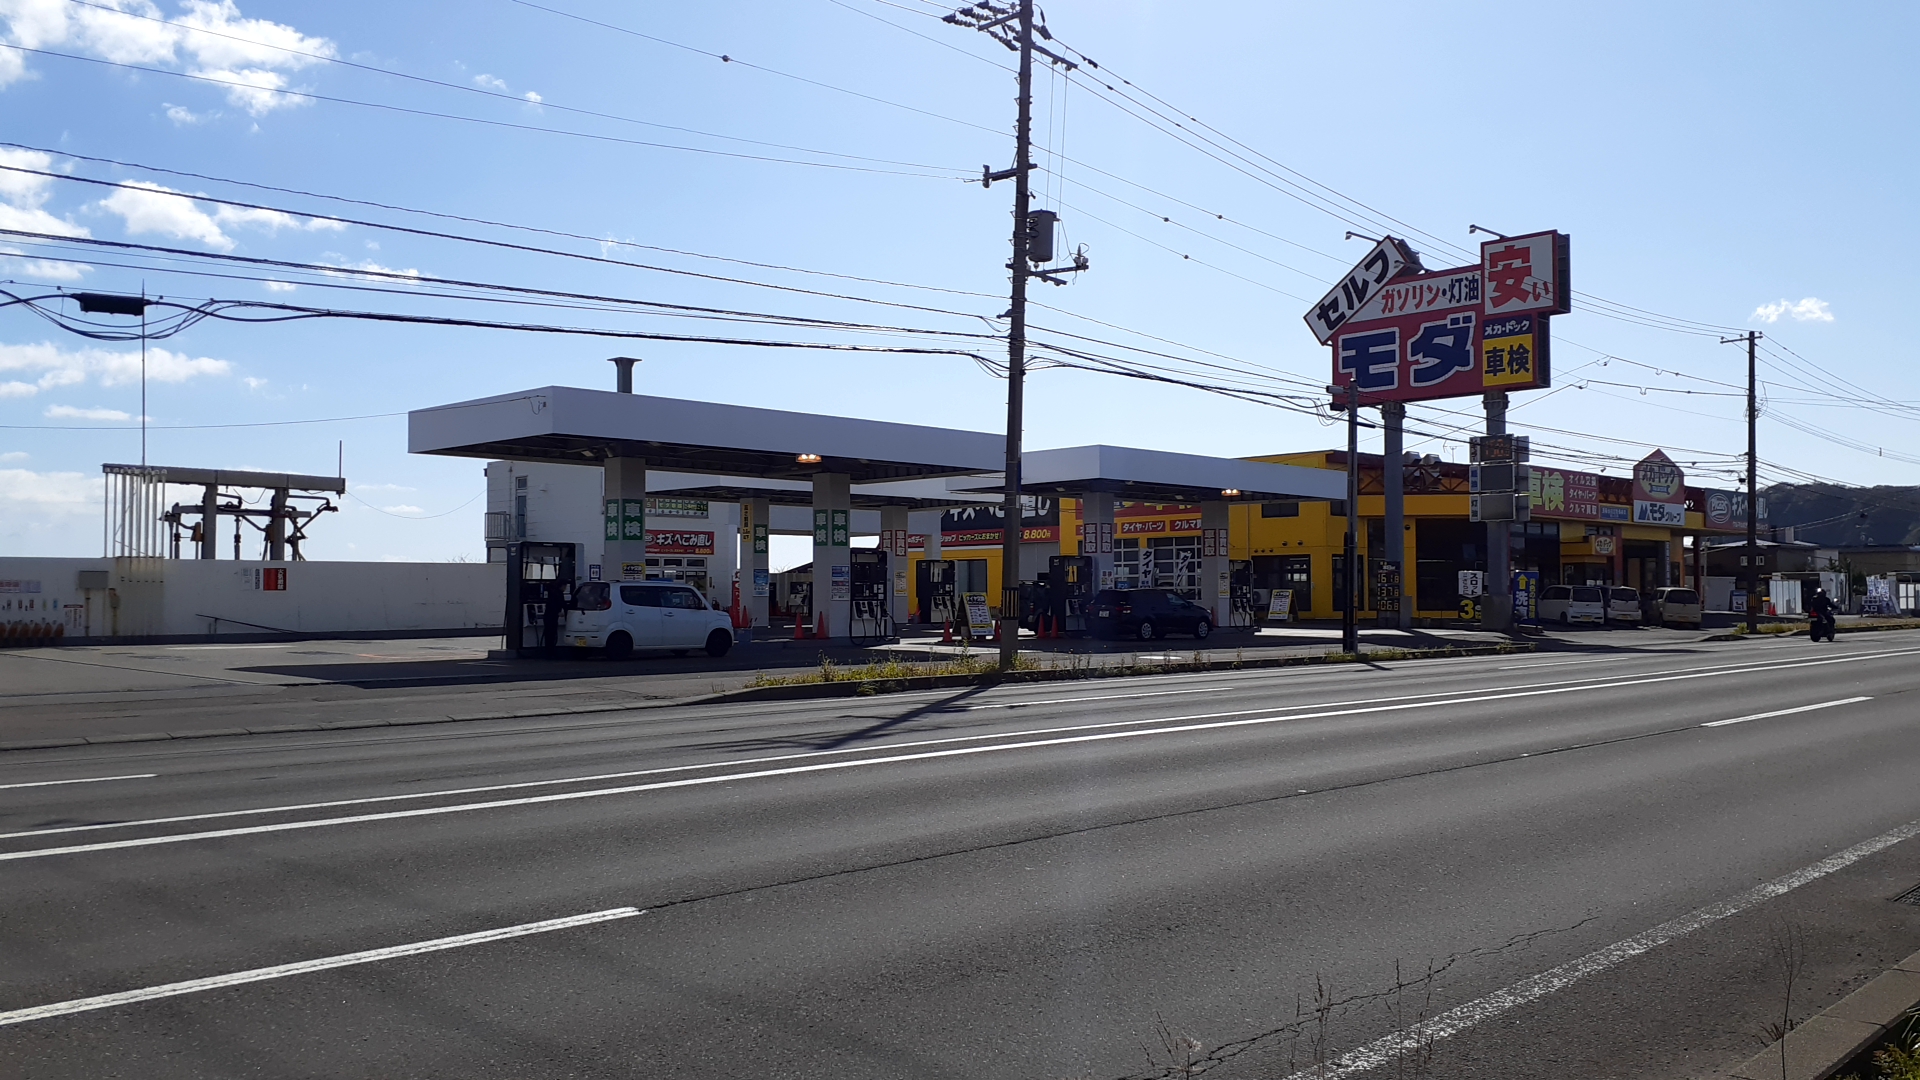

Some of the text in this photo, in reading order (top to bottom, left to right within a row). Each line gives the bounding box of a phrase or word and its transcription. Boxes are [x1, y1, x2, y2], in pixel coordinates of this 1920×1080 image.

[1316, 248, 1390, 331] セルフ
[1489, 245, 1550, 308] 安い
[1381, 275, 1480, 314] ガソリン・灯油
[1338, 310, 1476, 391] モダ
[1485, 343, 1530, 376] 車検
[607, 503, 618, 537] 車検
[625, 502, 641, 537] 車検
[816, 513, 827, 543] 車検
[834, 513, 846, 543] 車検
[1122, 521, 1164, 532] タイヤ・パーツ
[656, 533, 712, 546] キズ・へこみ直し
[755, 526, 767, 551] 車検
[1085, 524, 1097, 553] 車買取
[1102, 524, 1111, 553] 車買取
[1204, 529, 1216, 556] 車買取
[1142, 551, 1152, 578] タイヤ
[1460, 600, 1474, 619] 3
